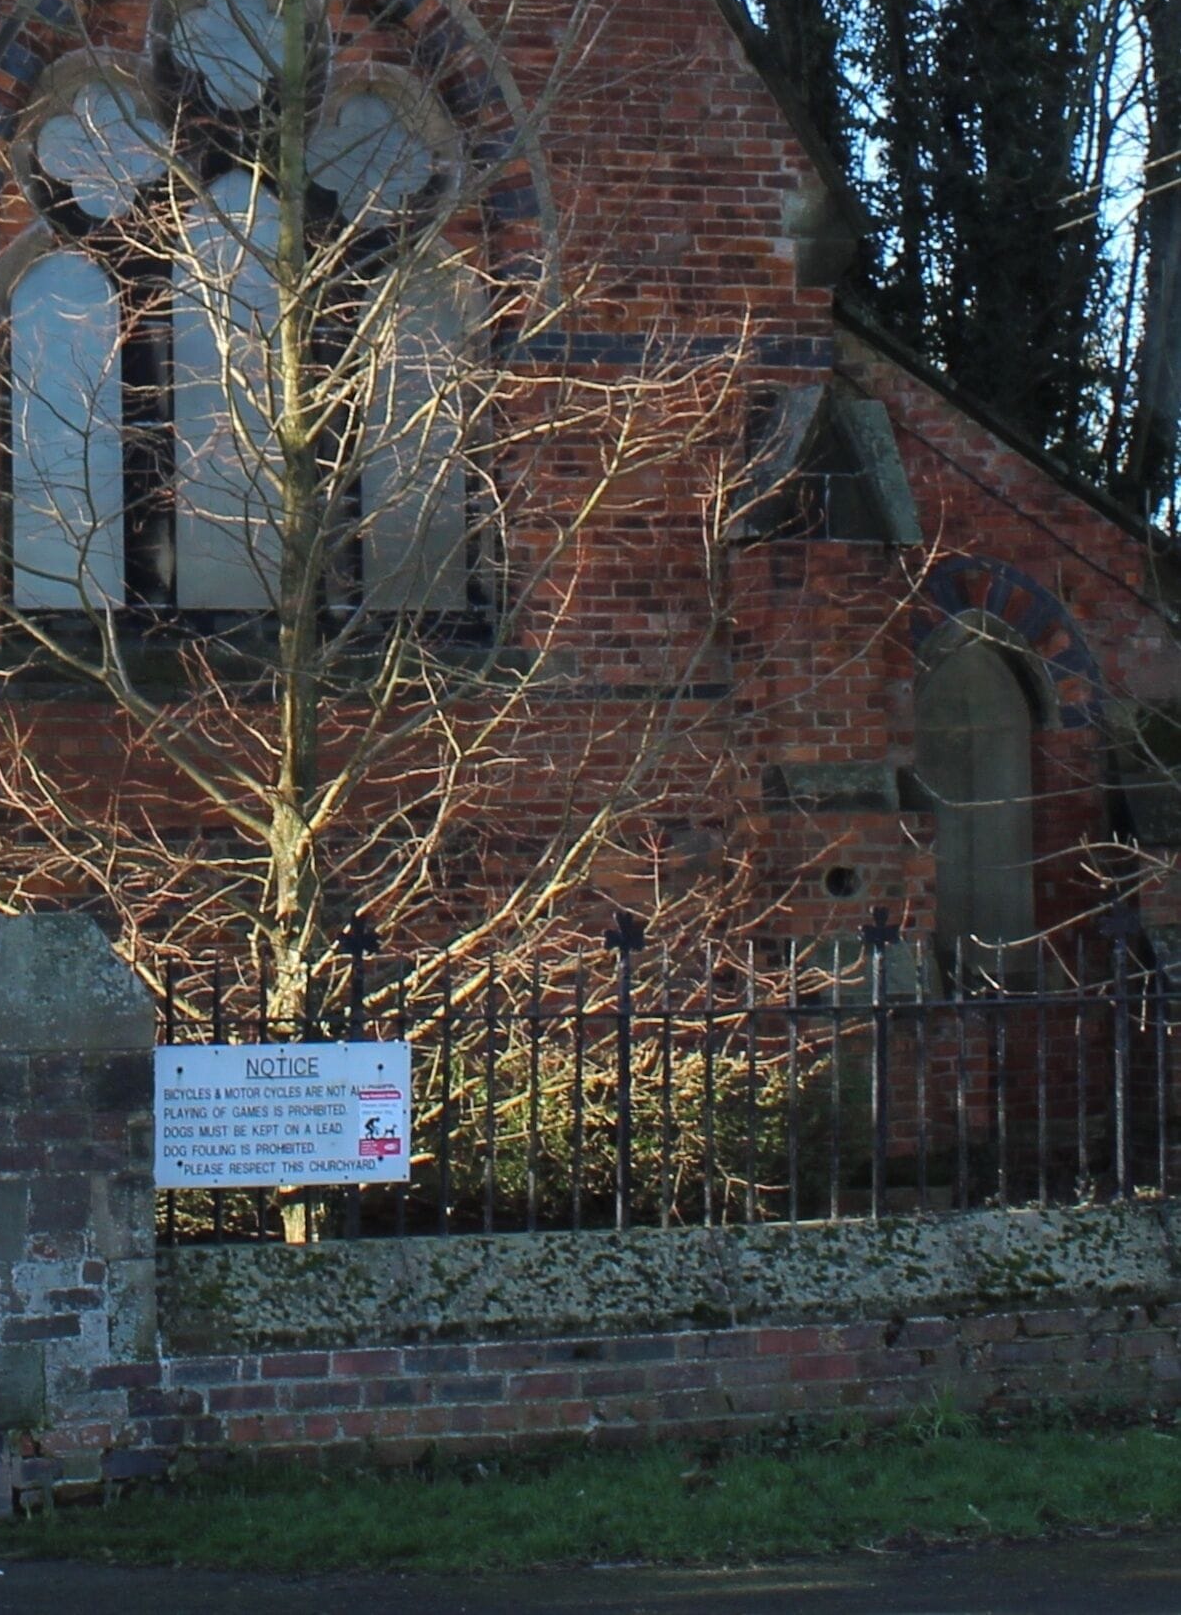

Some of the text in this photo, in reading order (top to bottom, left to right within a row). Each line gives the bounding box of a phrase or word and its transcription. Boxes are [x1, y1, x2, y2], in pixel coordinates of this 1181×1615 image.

[246, 1057, 318, 1078] NOTICE
[164, 1088, 211, 1100] BICYCLES
[215, 1088, 222, 1100] &
[225, 1087, 260, 1099] MOTOR
[264, 1086, 301, 1099] CYCLES
[305, 1086, 323, 1098] ARE
[327, 1085, 346, 1098] NOT
[164, 1107, 207, 1119] PLAYING
[212, 1107, 226, 1118] OF
[232, 1107, 268, 1118] GAMES
[273, 1106, 283, 1117] IS
[164, 1127, 194, 1138] DOGS
[199, 1126, 228, 1137] MUST
[234, 1126, 247, 1136] BE
[252, 1125, 279, 1136] KEPT
[285, 1124, 300, 1135] ON
[305, 1123, 311, 1134] A
[164, 1145, 186, 1157] DOG
[192, 1144, 236, 1156] FOULING
[241, 1144, 251, 1155] IS
[184, 1163, 224, 1175] PLEASE
[229, 1161, 275, 1174] RESPECT
[283, 1160, 304, 1173] THIS
